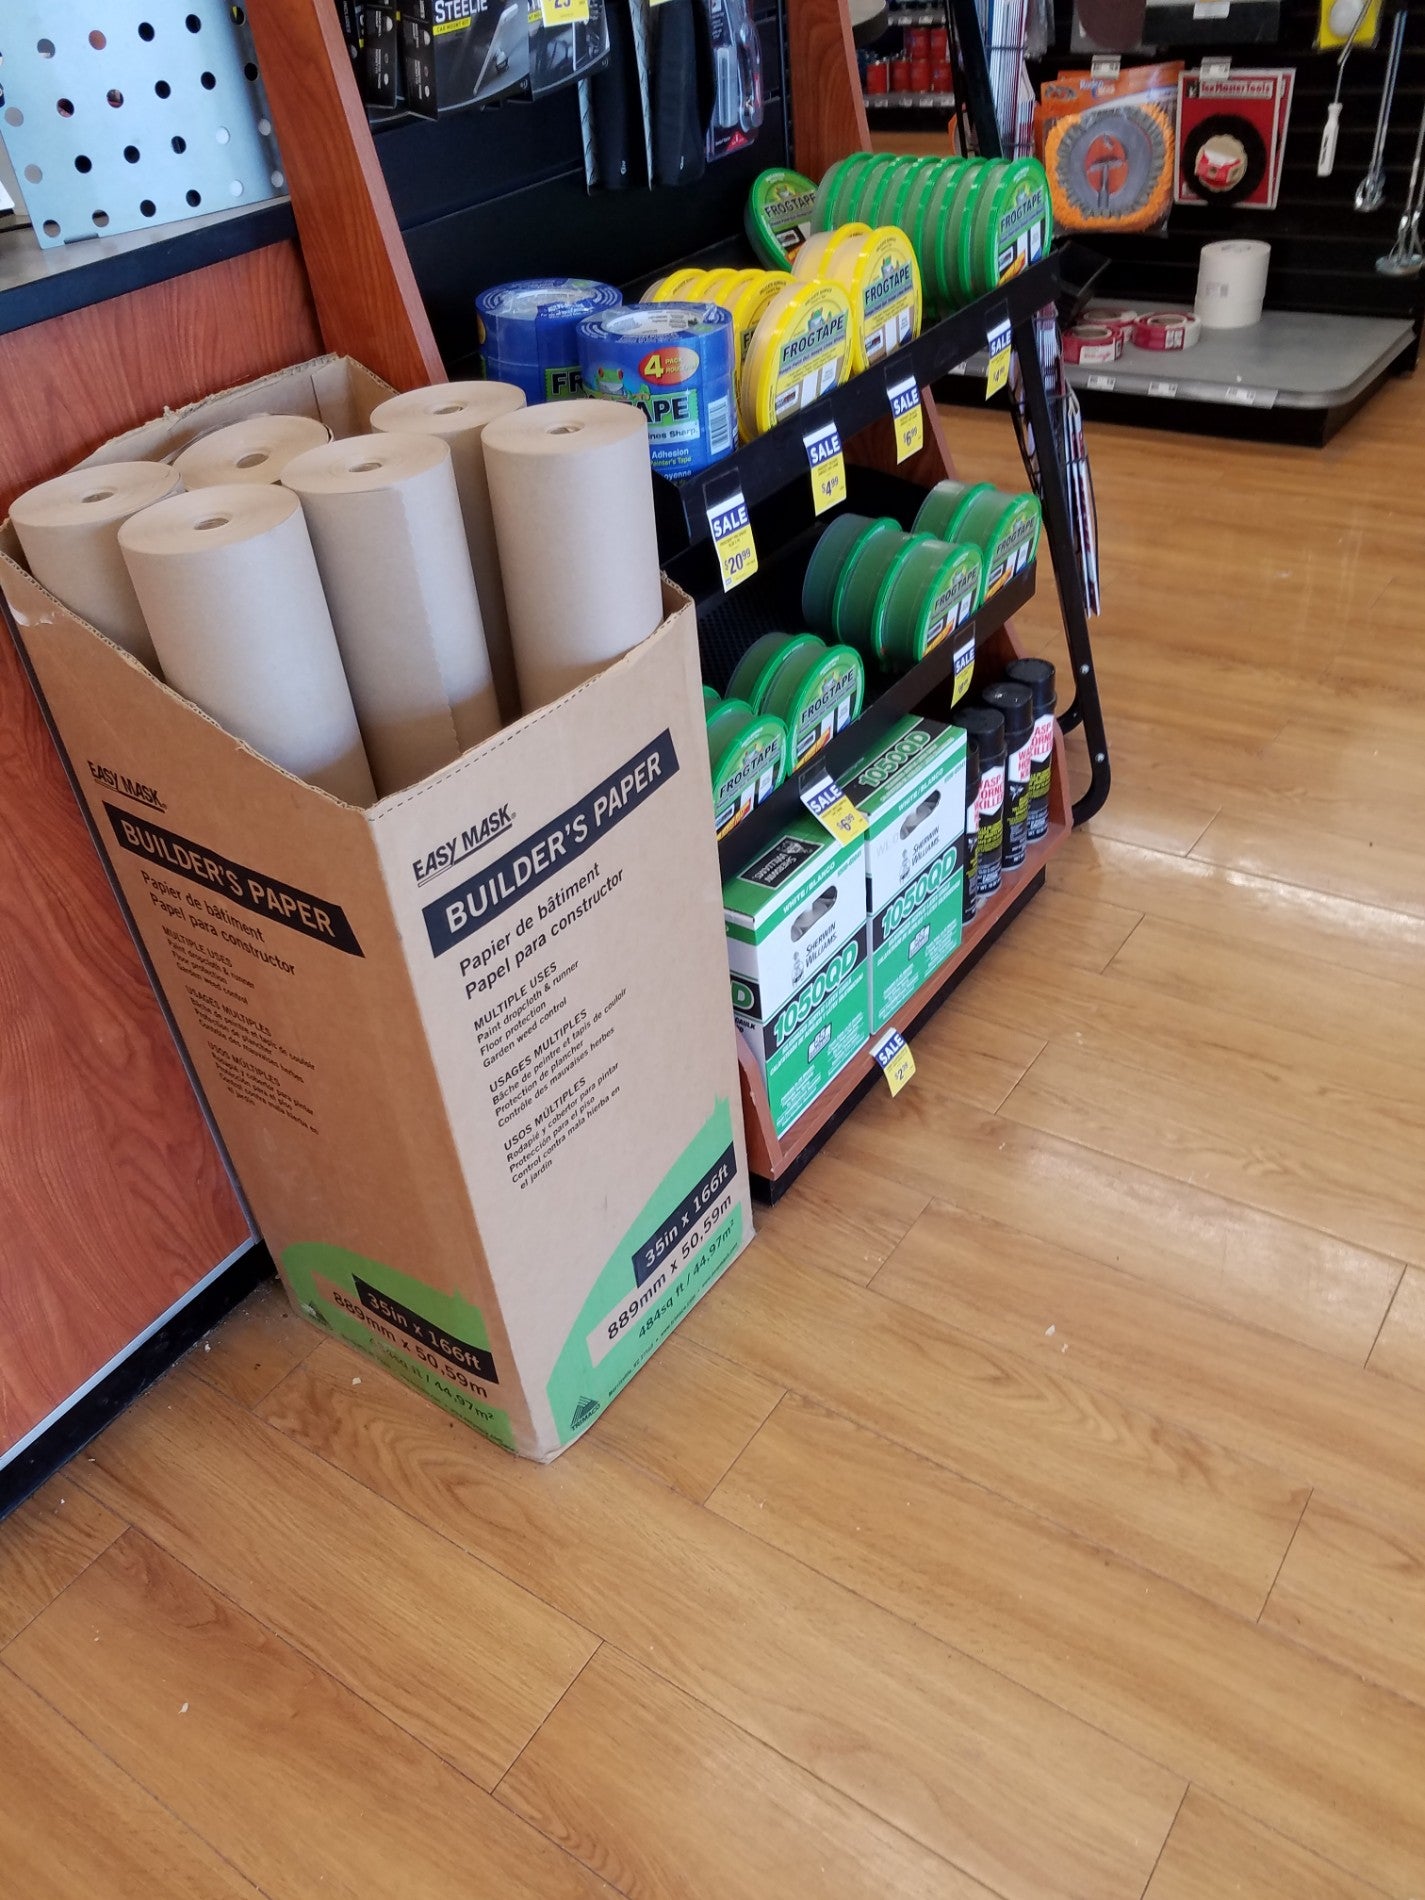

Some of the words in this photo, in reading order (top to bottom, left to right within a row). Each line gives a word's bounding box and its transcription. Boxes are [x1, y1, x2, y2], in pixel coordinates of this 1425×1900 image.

[435, 0, 488, 23] STEELIE
[1000, 190, 1042, 233] FROGTAPE
[865, 265, 910, 305] FROGTAPE
[783, 314, 845, 362] FROGTAPE
[991, 329, 1012, 356] SALE
[552, 372, 583, 395] FR
[644, 355, 664, 378] 4
[635, 397, 690, 423] APE
[893, 387, 920, 416] SALE
[651, 448, 689, 460] Adhesion
[810, 435, 841, 464] SALE
[713, 506, 748, 538] SALE
[996, 515, 1034, 554] FROGTAPE
[934, 566, 978, 611] FROGTAPE
[956, 647, 976, 674] SALE
[801, 669, 854, 724] FROGTAPE
[87, 760, 118, 788] EASY
[123, 776, 162, 806] MASK
[720, 739, 779, 799] FROGTAPE
[858, 730, 931, 788] 1050QD
[810, 784, 843, 813] SALE
[412, 837, 458, 883] EASY
[461, 803, 513, 852] MASK
[445, 814, 588, 934] BUILDER'S
[593, 751, 662, 828] PAPER
[913, 825, 940, 853] SHERWIN
[120, 819, 243, 897] BUILDER'S
[247, 878, 336, 938] PAPER
[881, 846, 957, 939] 1050QD
[140, 870, 182, 900] Papier
[186, 893, 202, 911] de
[203, 900, 265, 944] bâtiment
[150, 892, 187, 922] Papel
[189, 914, 219, 937] para
[221, 931, 296, 976] constructor
[459, 932, 511, 978] Papier
[515, 916, 534, 938] de
[537, 862, 601, 921] bâtiment
[465, 957, 511, 1001] Papel
[515, 933, 547, 968] para
[551, 868, 624, 937] constructor
[162, 925, 205, 955] MULTIPLE
[806, 922, 837, 956] SHERWIN
[473, 985, 528, 1032] MULTIPLE
[529, 961, 558, 989] USES
[476, 1022, 502, 1044] Paint
[503, 989, 543, 1026] dropcloth
[544, 983, 551, 993] &
[552, 960, 580, 987] runner
[773, 940, 859, 1047] 1050QD
[479, 1036, 503, 1057] Floor
[505, 1001, 547, 1040] protection
[482, 1039, 516, 1069] Garden
[516, 1023, 538, 1044] weed
[539, 996, 568, 1025] control
[489, 1055, 532, 1094] USAGES
[533, 1008, 588, 1059] MULTIPLES
[492, 1080, 520, 1106] Bâche
[521, 1072, 532, 1084] de
[533, 1048, 562, 1075] peintre
[562, 1038, 571, 1049] et
[572, 1021, 591, 1042] tapis
[592, 1012, 603, 1024] de
[604, 987, 627, 1014] couloir
[879, 1033, 904, 1065] SALE
[494, 1079, 538, 1118] Protection
[539, 1069, 550, 1082] de
[550, 1040, 584, 1075] plancher
[497, 1097, 533, 1128] Contrôle
[534, 1084, 549, 1099] des
[549, 1049, 590, 1086] mauvaises
[590, 1027, 615, 1052] herbes
[503, 1123, 533, 1152] USOS
[506, 1131, 540, 1163] Rodapié
[541, 1126, 547, 1136] y
[547, 1098, 578, 1129] cobertor
[579, 1083, 596, 1101] para
[597, 1062, 619, 1086] pintar
[512, 1155, 542, 1184] Control
[543, 1134, 566, 1159] contra
[567, 1116, 586, 1136] mala
[586, 1094, 610, 1119] hierba
[610, 1085, 621, 1097] en
[552, 1120, 570, 1138] para
[570, 1109, 578, 1121] el
[579, 1096, 595, 1114] piso
[520, 1178, 529, 1190] el
[644, 1226, 680, 1268] 35in
[681, 1211, 690, 1229] x
[693, 1163, 729, 1214] 166ft
[332, 1291, 397, 1342] 889mm
[401, 1339, 411, 1353] x
[607, 1273, 667, 1341] 889mm
[670, 1259, 678, 1275] x
[638, 1296, 674, 1339] 484sq
[675, 1282, 685, 1297] ft
[686, 1272, 691, 1286] /
[367, 1292, 409, 1328] 35in
[413, 1322, 423, 1338] x
[427, 1331, 482, 1372] 166ft
[570, 1402, 601, 1431] TRIMACO
